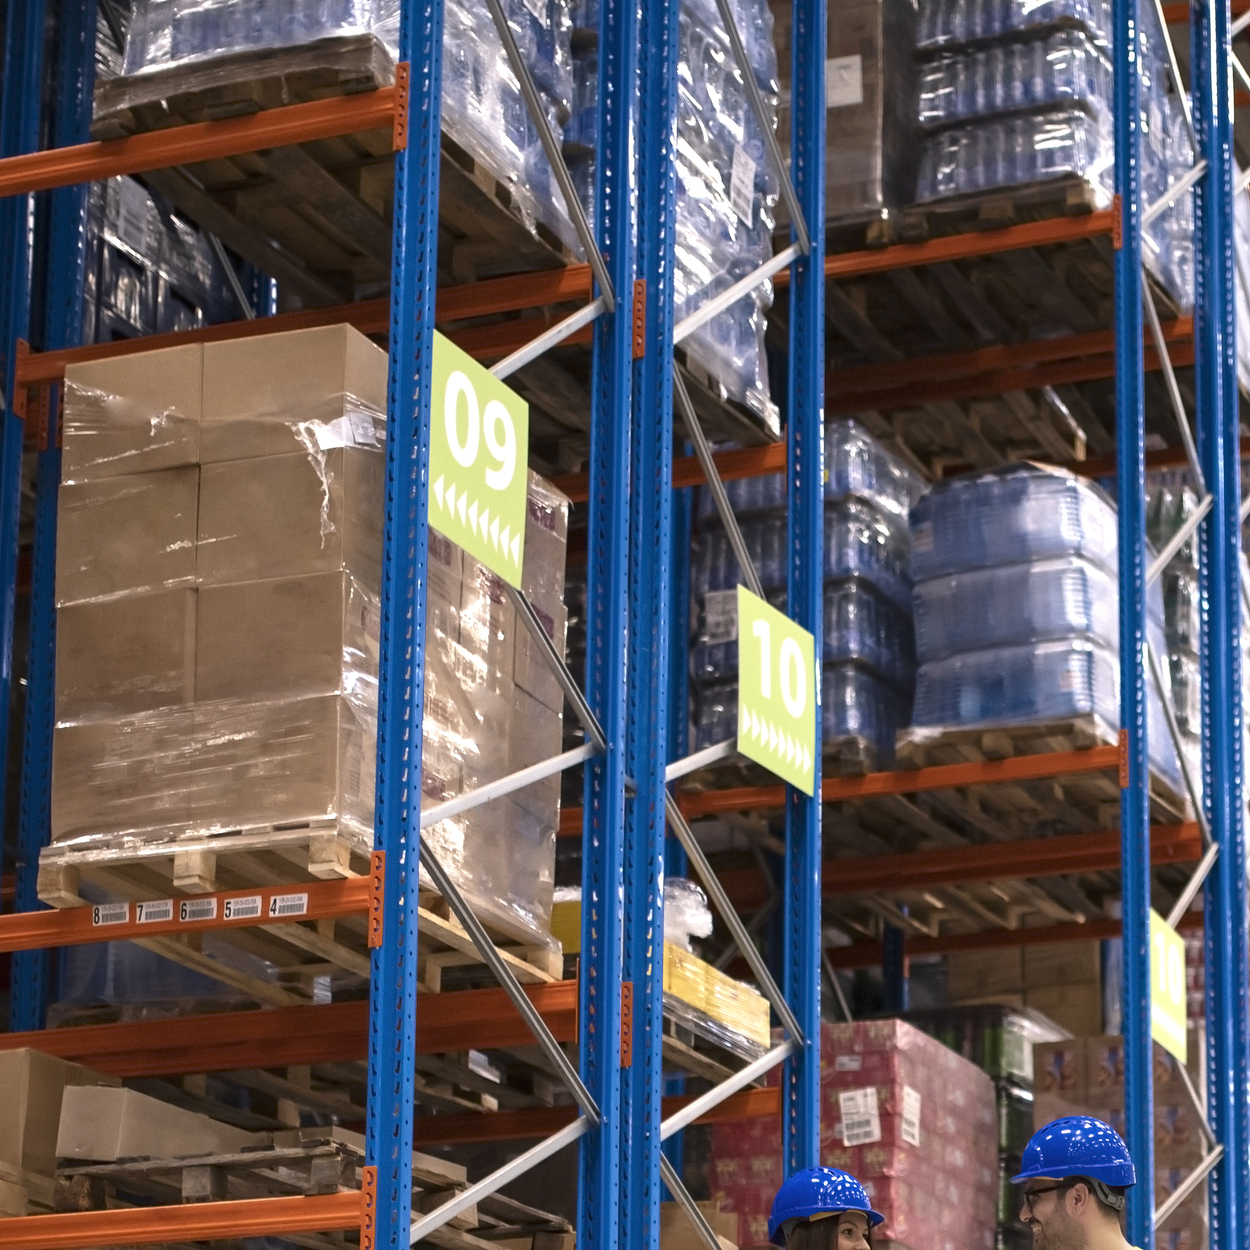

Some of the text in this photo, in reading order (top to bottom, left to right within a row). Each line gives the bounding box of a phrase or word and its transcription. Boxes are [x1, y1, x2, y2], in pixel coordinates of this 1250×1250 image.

[443, 370, 516, 490] 09
[753, 619, 806, 718] 10
[93, 906, 100, 924] 8
[137, 904, 144, 922] 7
[180, 902, 187, 920] 6
[224, 901, 231, 918] 5
[269, 898, 277, 915] 4
[1155, 932, 1183, 1005] 10
